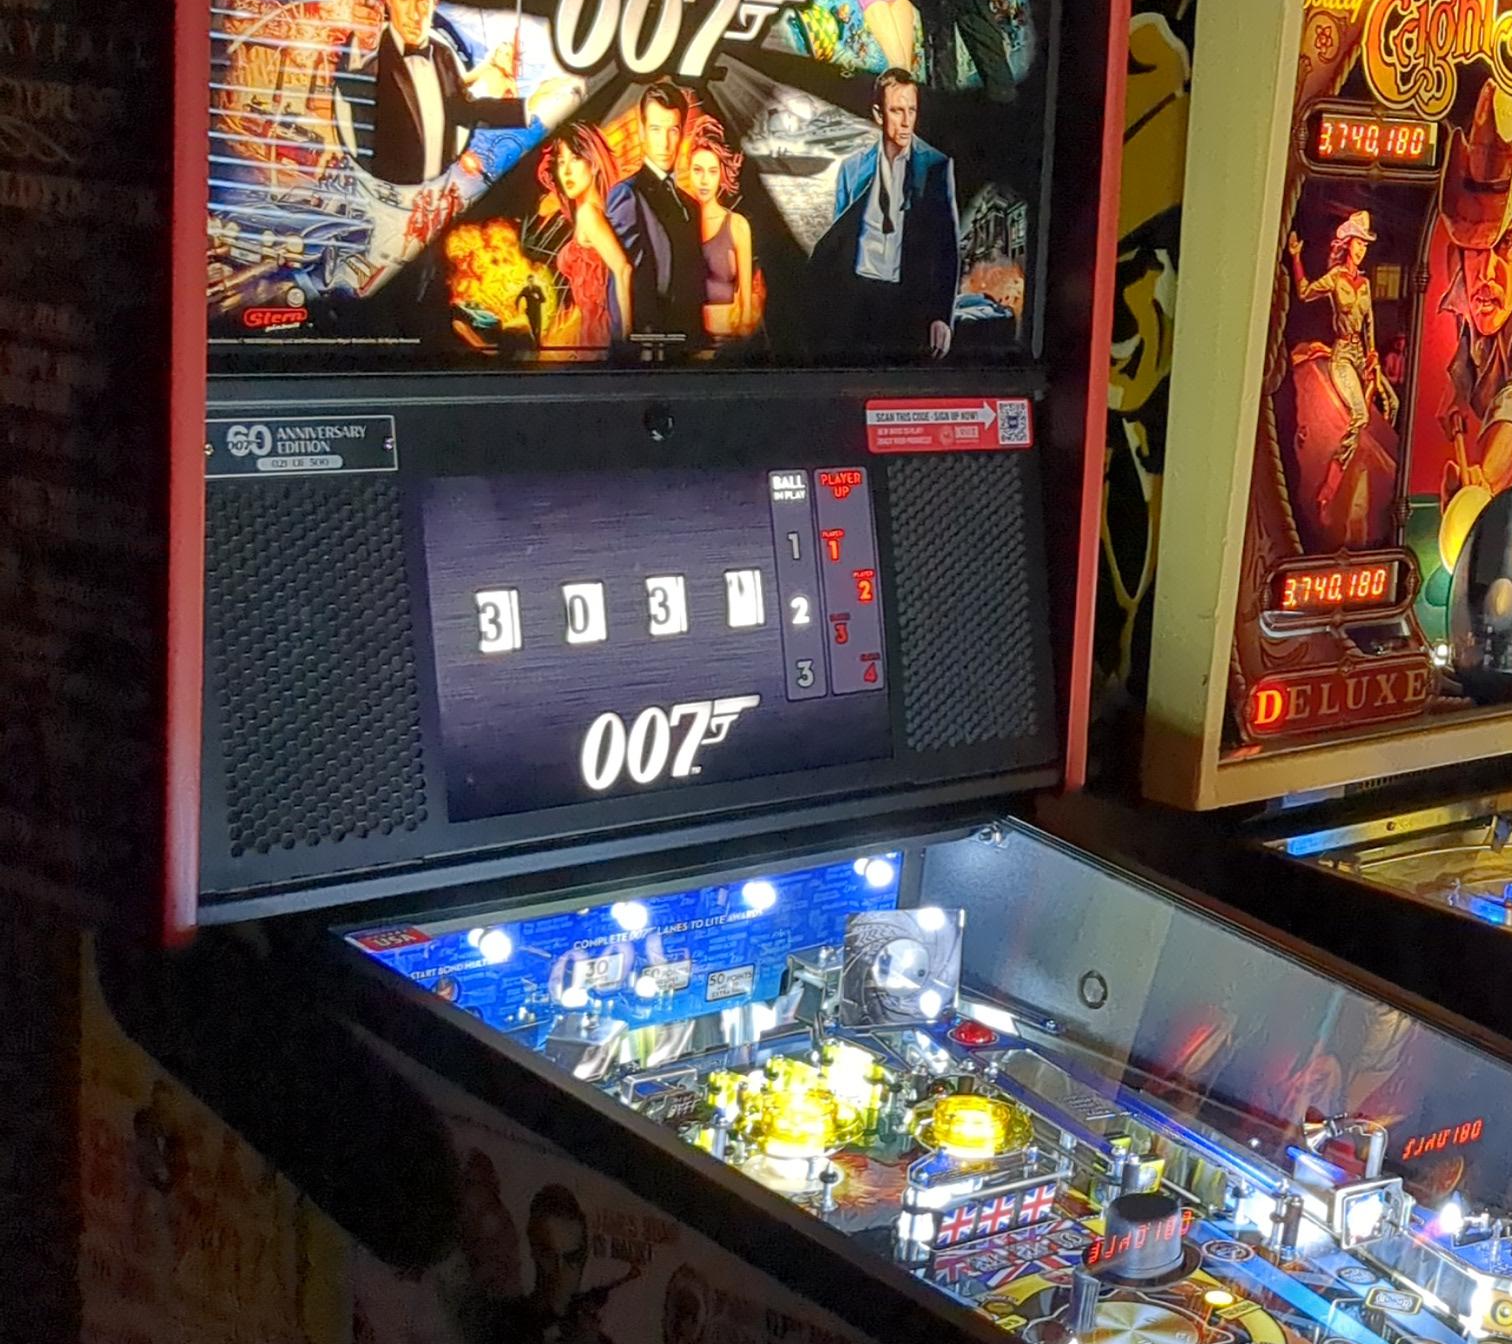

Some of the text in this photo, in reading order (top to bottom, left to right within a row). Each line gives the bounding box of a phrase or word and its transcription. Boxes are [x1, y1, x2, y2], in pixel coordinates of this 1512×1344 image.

[248, 310, 303, 327] Stern
[226, 424, 273, 457] 60
[276, 425, 367, 440] ANNIVERSARY
[276, 440, 331, 454] EDITION
[772, 475, 806, 490] BALL
[820, 471, 862, 485] PLAYER
[784, 489, 806, 500] PLAY
[834, 486, 850, 498] UP
[788, 532, 800, 560] 1
[828, 539, 839, 560] 1
[858, 579, 872, 600] 2
[480, 585, 672, 643] 3 0 3
[789, 596, 811, 625] 2
[834, 623, 849, 644] 3
[796, 659, 815, 687] 3
[863, 662, 878, 684] 4
[1254, 668, 1429, 725] DELUXE
[581, 699, 713, 790] 007
[373, 932, 416, 948] USA
[573, 931, 630, 950] COMPLETE
[656, 922, 689, 937] LANES
[690, 919, 704, 931] TO
[705, 915, 725, 928] LITE
[410, 968, 437, 981] START
